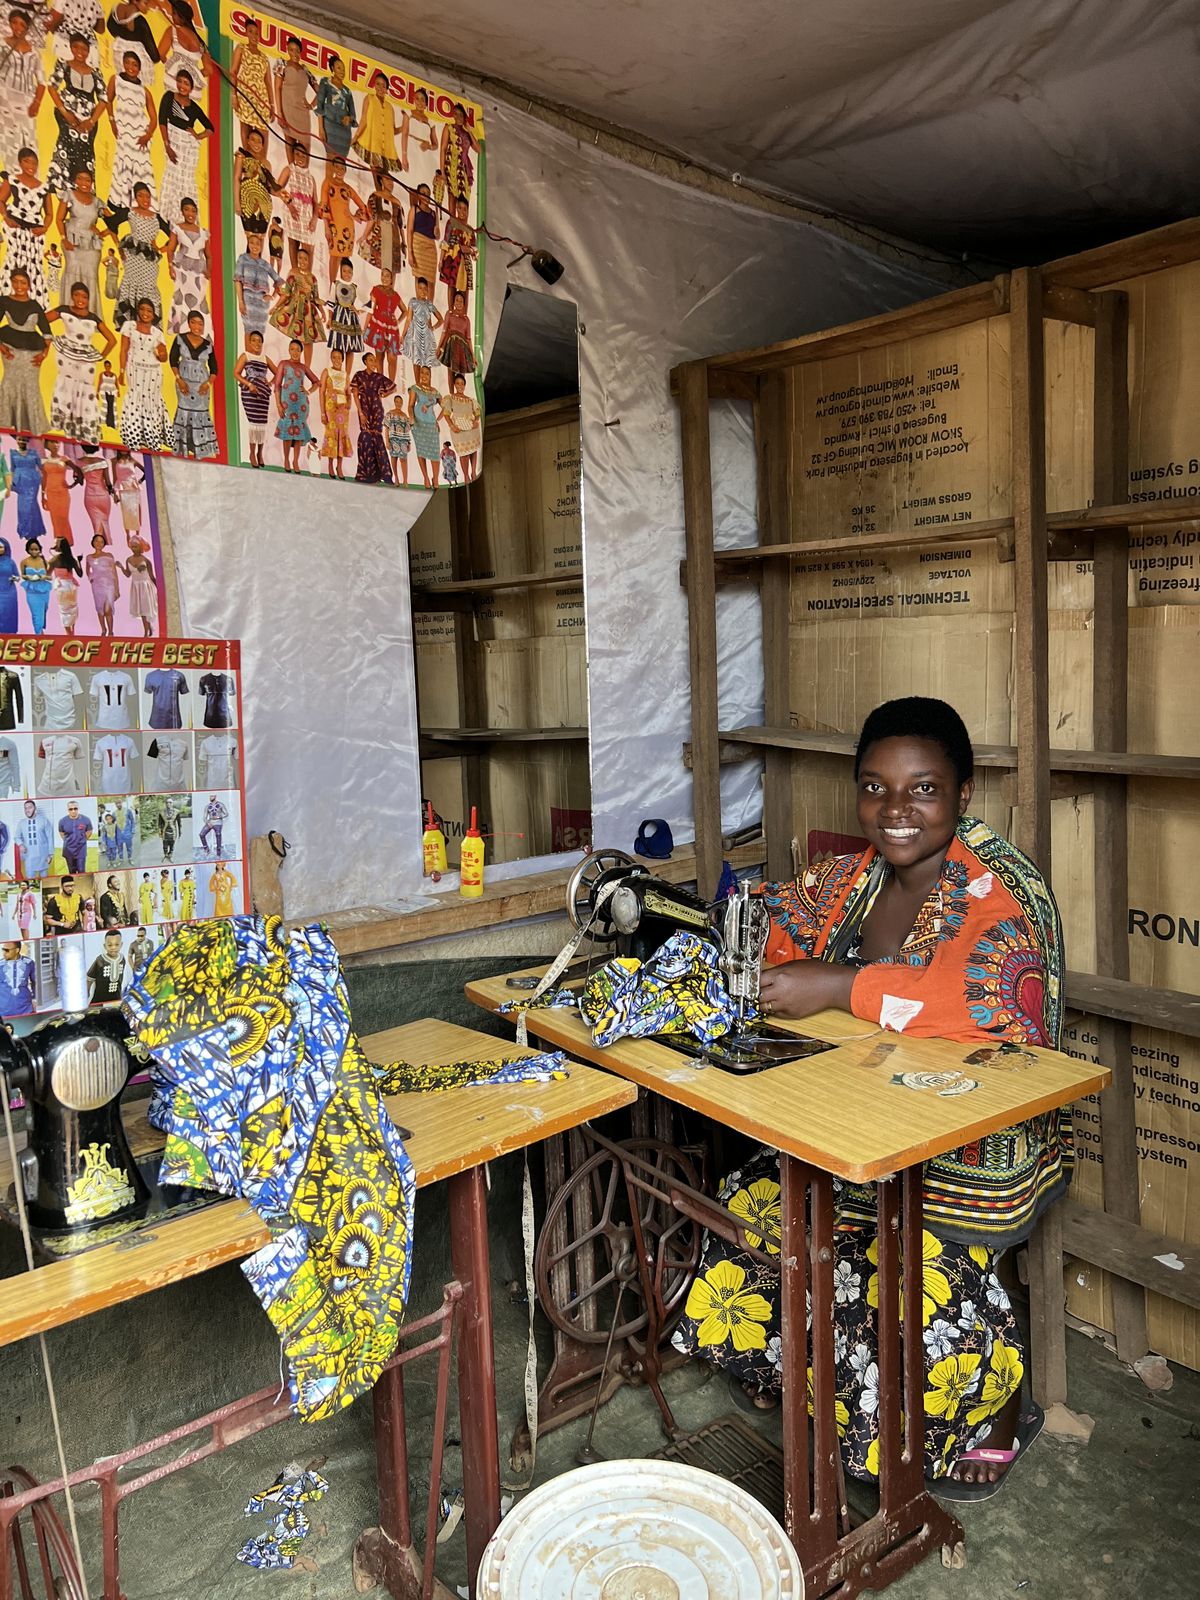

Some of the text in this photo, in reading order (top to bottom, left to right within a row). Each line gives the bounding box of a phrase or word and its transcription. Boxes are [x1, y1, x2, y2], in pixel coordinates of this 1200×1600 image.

[230, 10, 341, 72] SUPER
[927, 364, 958, 379] Email:
[917, 379, 960, 395] Website:
[896, 403, 917, 416] +250
[920, 397, 936, 409] Tel:
[859, 412, 874, 424] 390
[877, 409, 894, 421] 788
[903, 413, 947, 431] Bugesera
[824, 431, 860, 446] Rwanda
[869, 423, 900, 438] District
[930, 427, 963, 441] SHOW
[877, 438, 896, 452] MIC
[899, 434, 928, 449] ROOM
[811, 454, 821, 464] 32
[838, 442, 875, 461] building
[806, 442, 968, 479] Located in Bugesera Industrial Park
[1131, 463, 1183, 482] system
[852, 492, 971, 515] GROSS WEIGHT 36 KG
[852, 512, 972, 533] NET WEIGHT 32 KG
[920, 550, 971, 562] DIMENSION
[1130, 556, 1193, 573] indicatin
[929, 569, 971, 580] VOLTAGE
[1139, 578, 1200, 592] freezing
[807, 590, 970, 610] TECHNICAL SPECIFICATION
[61, 640, 101, 663] OF
[110, 642, 156, 664] THE
[162, 643, 219, 666] BEST
[1128, 908, 1200, 946] RON
[1131, 1045, 1179, 1067] eezing
[1132, 1064, 1198, 1093] ndicating
[1077, 1146, 1104, 1163] glas
